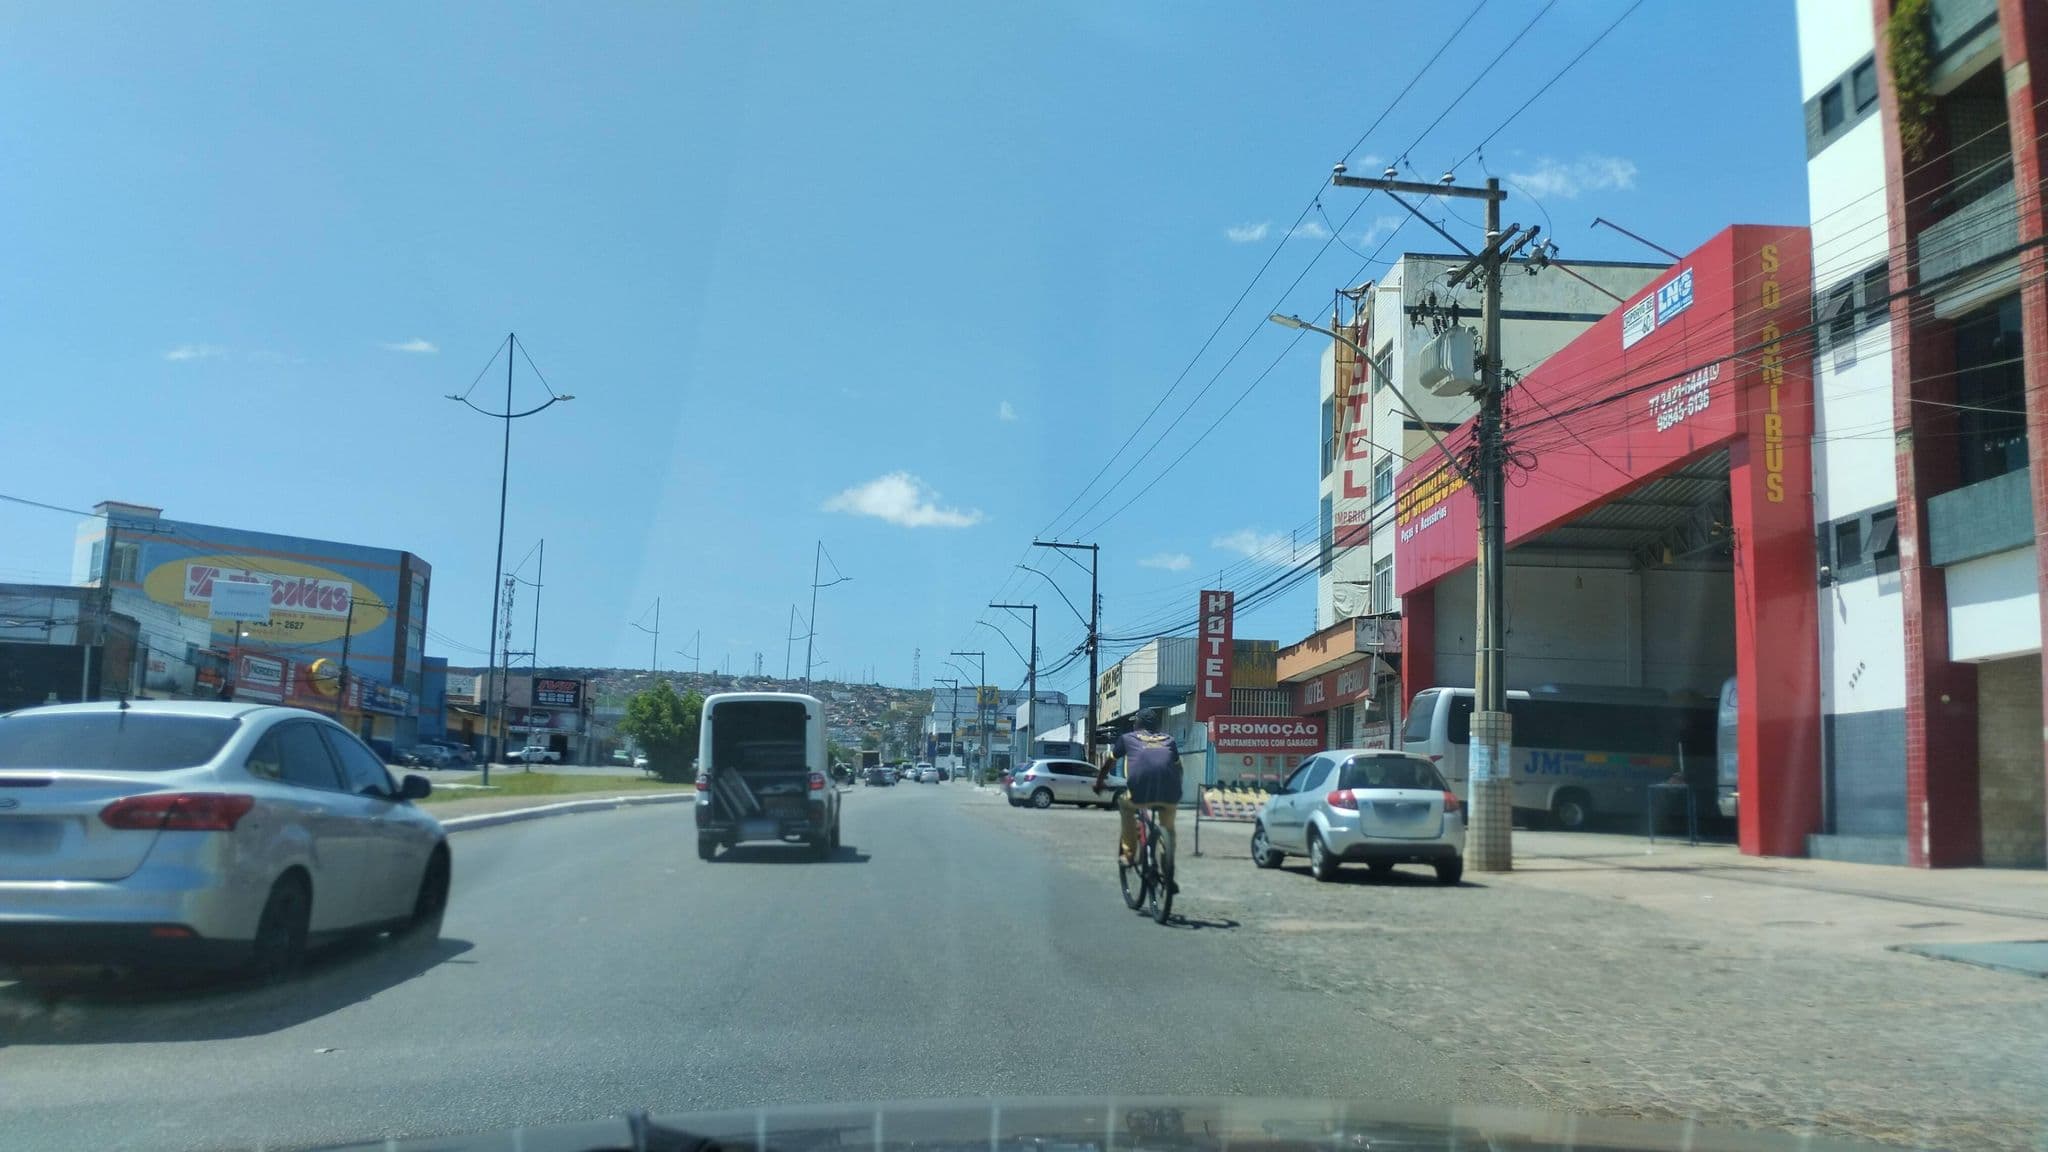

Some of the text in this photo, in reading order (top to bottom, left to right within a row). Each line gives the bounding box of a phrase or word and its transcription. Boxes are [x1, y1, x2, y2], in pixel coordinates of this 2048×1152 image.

[1648, 394, 1660, 417] 77
[1205, 594, 1227, 698] HOTEL
[1304, 680, 1325, 705] HOTEL
[1219, 722, 1319, 737] PROMOÇÃO
[1218, 738, 1319, 748] APARTAMENTOS COM GARAGEM
